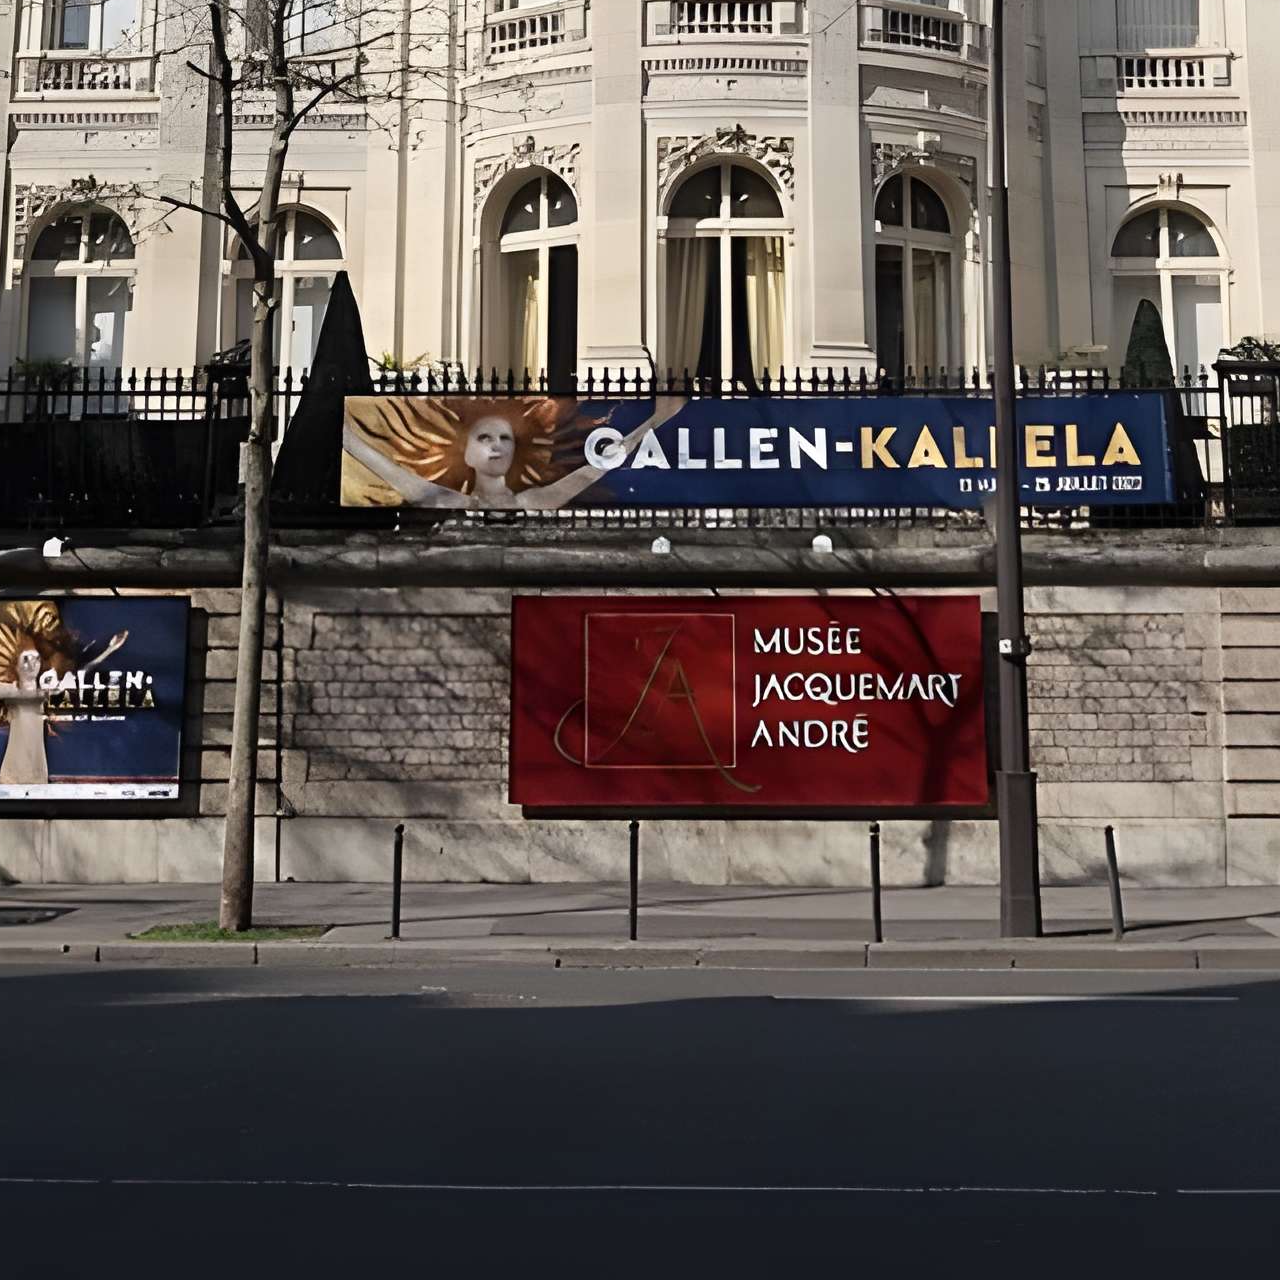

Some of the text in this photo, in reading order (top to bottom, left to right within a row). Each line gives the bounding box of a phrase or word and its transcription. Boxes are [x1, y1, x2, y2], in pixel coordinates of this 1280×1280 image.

[584, 422, 1141, 471] GALLEN-KALELA
[753, 621, 861, 655] MUSÉE
[752, 672, 962, 708] JACQUEMART
[751, 713, 869, 753] ANDRÉ
